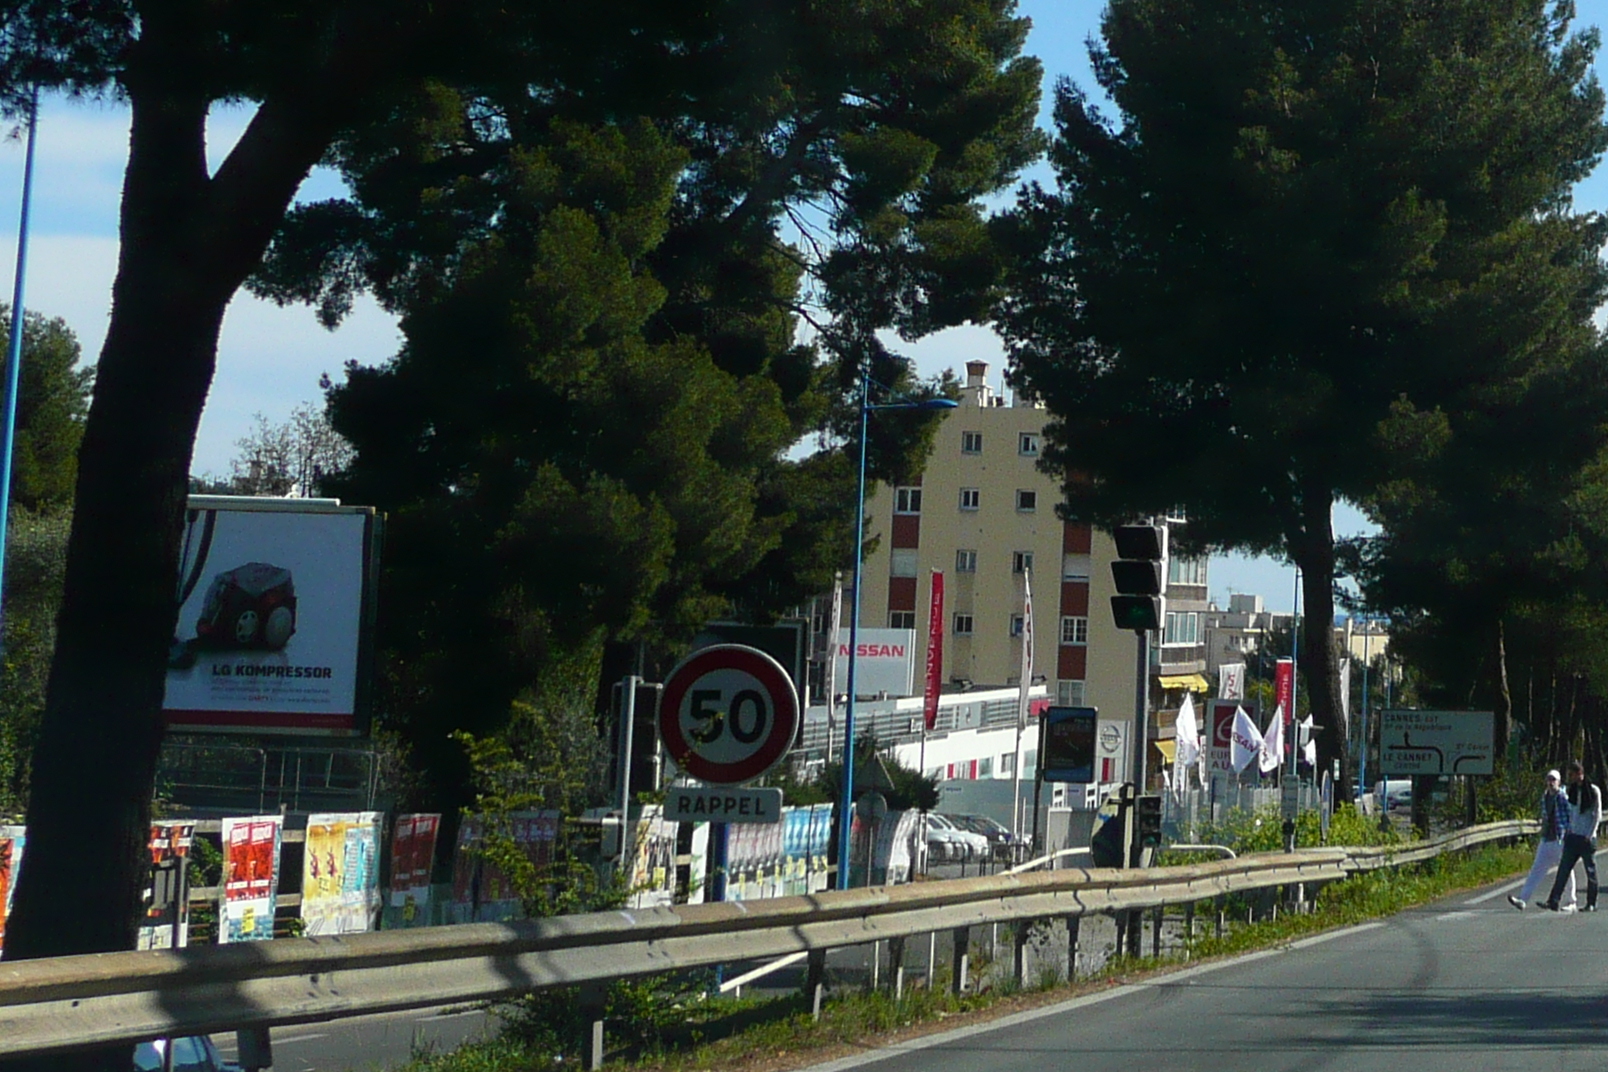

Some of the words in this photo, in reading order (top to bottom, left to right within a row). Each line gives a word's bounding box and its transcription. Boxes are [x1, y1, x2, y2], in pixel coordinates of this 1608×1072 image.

[839, 644, 904, 657] NSSAN
[212, 664, 231, 676] LG
[235, 664, 332, 679] KOMPRESSOR
[689, 689, 767, 744] 50
[678, 795, 767, 816] RAPPEL
